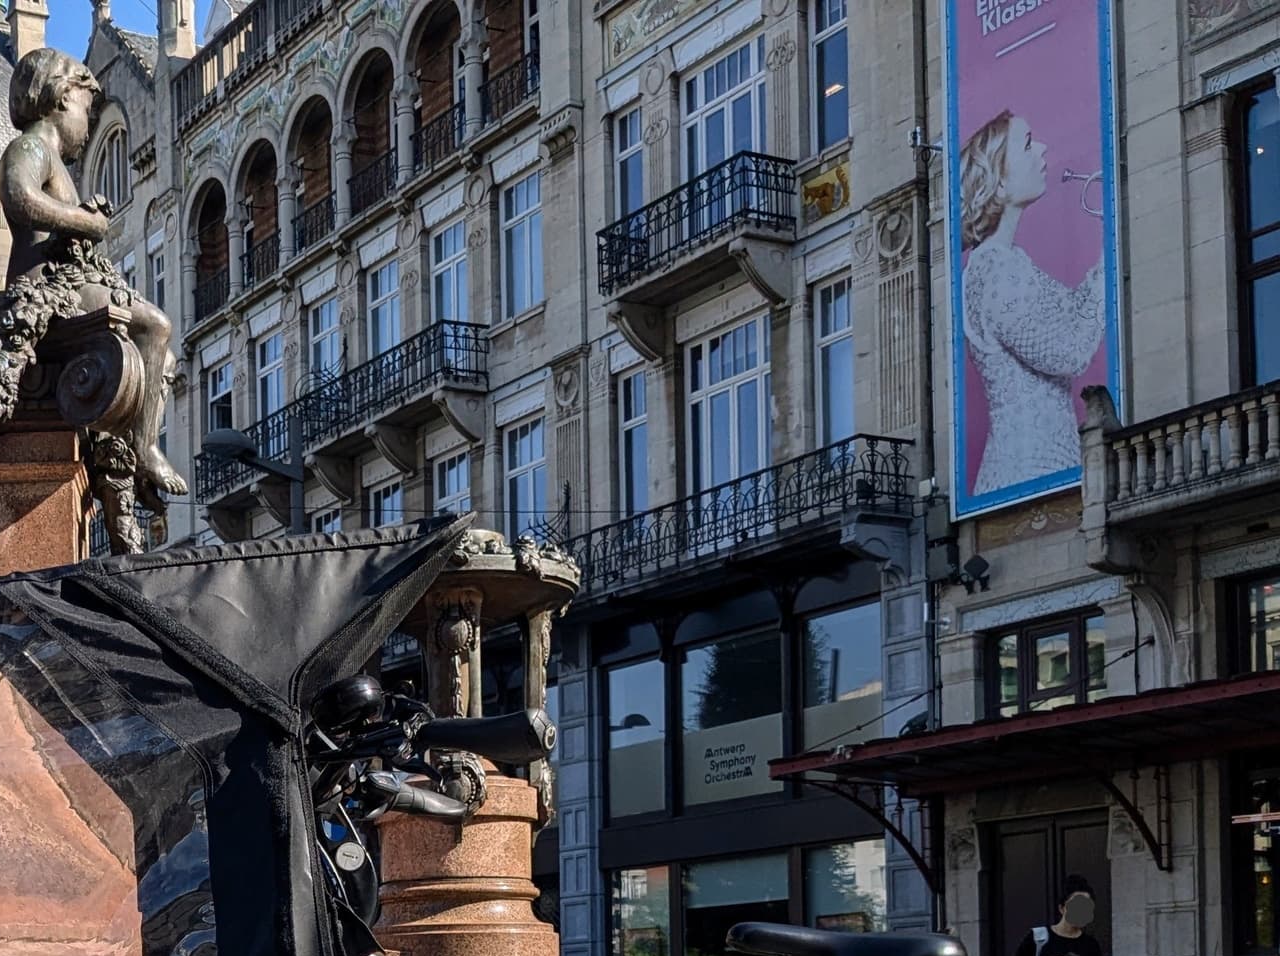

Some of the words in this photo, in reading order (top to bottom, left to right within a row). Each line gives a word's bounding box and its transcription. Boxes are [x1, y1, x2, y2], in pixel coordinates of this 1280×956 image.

[983, 0, 1048, 36] Klass
[704, 744, 745, 759] Antwerp
[710, 754, 756, 772] Symphony
